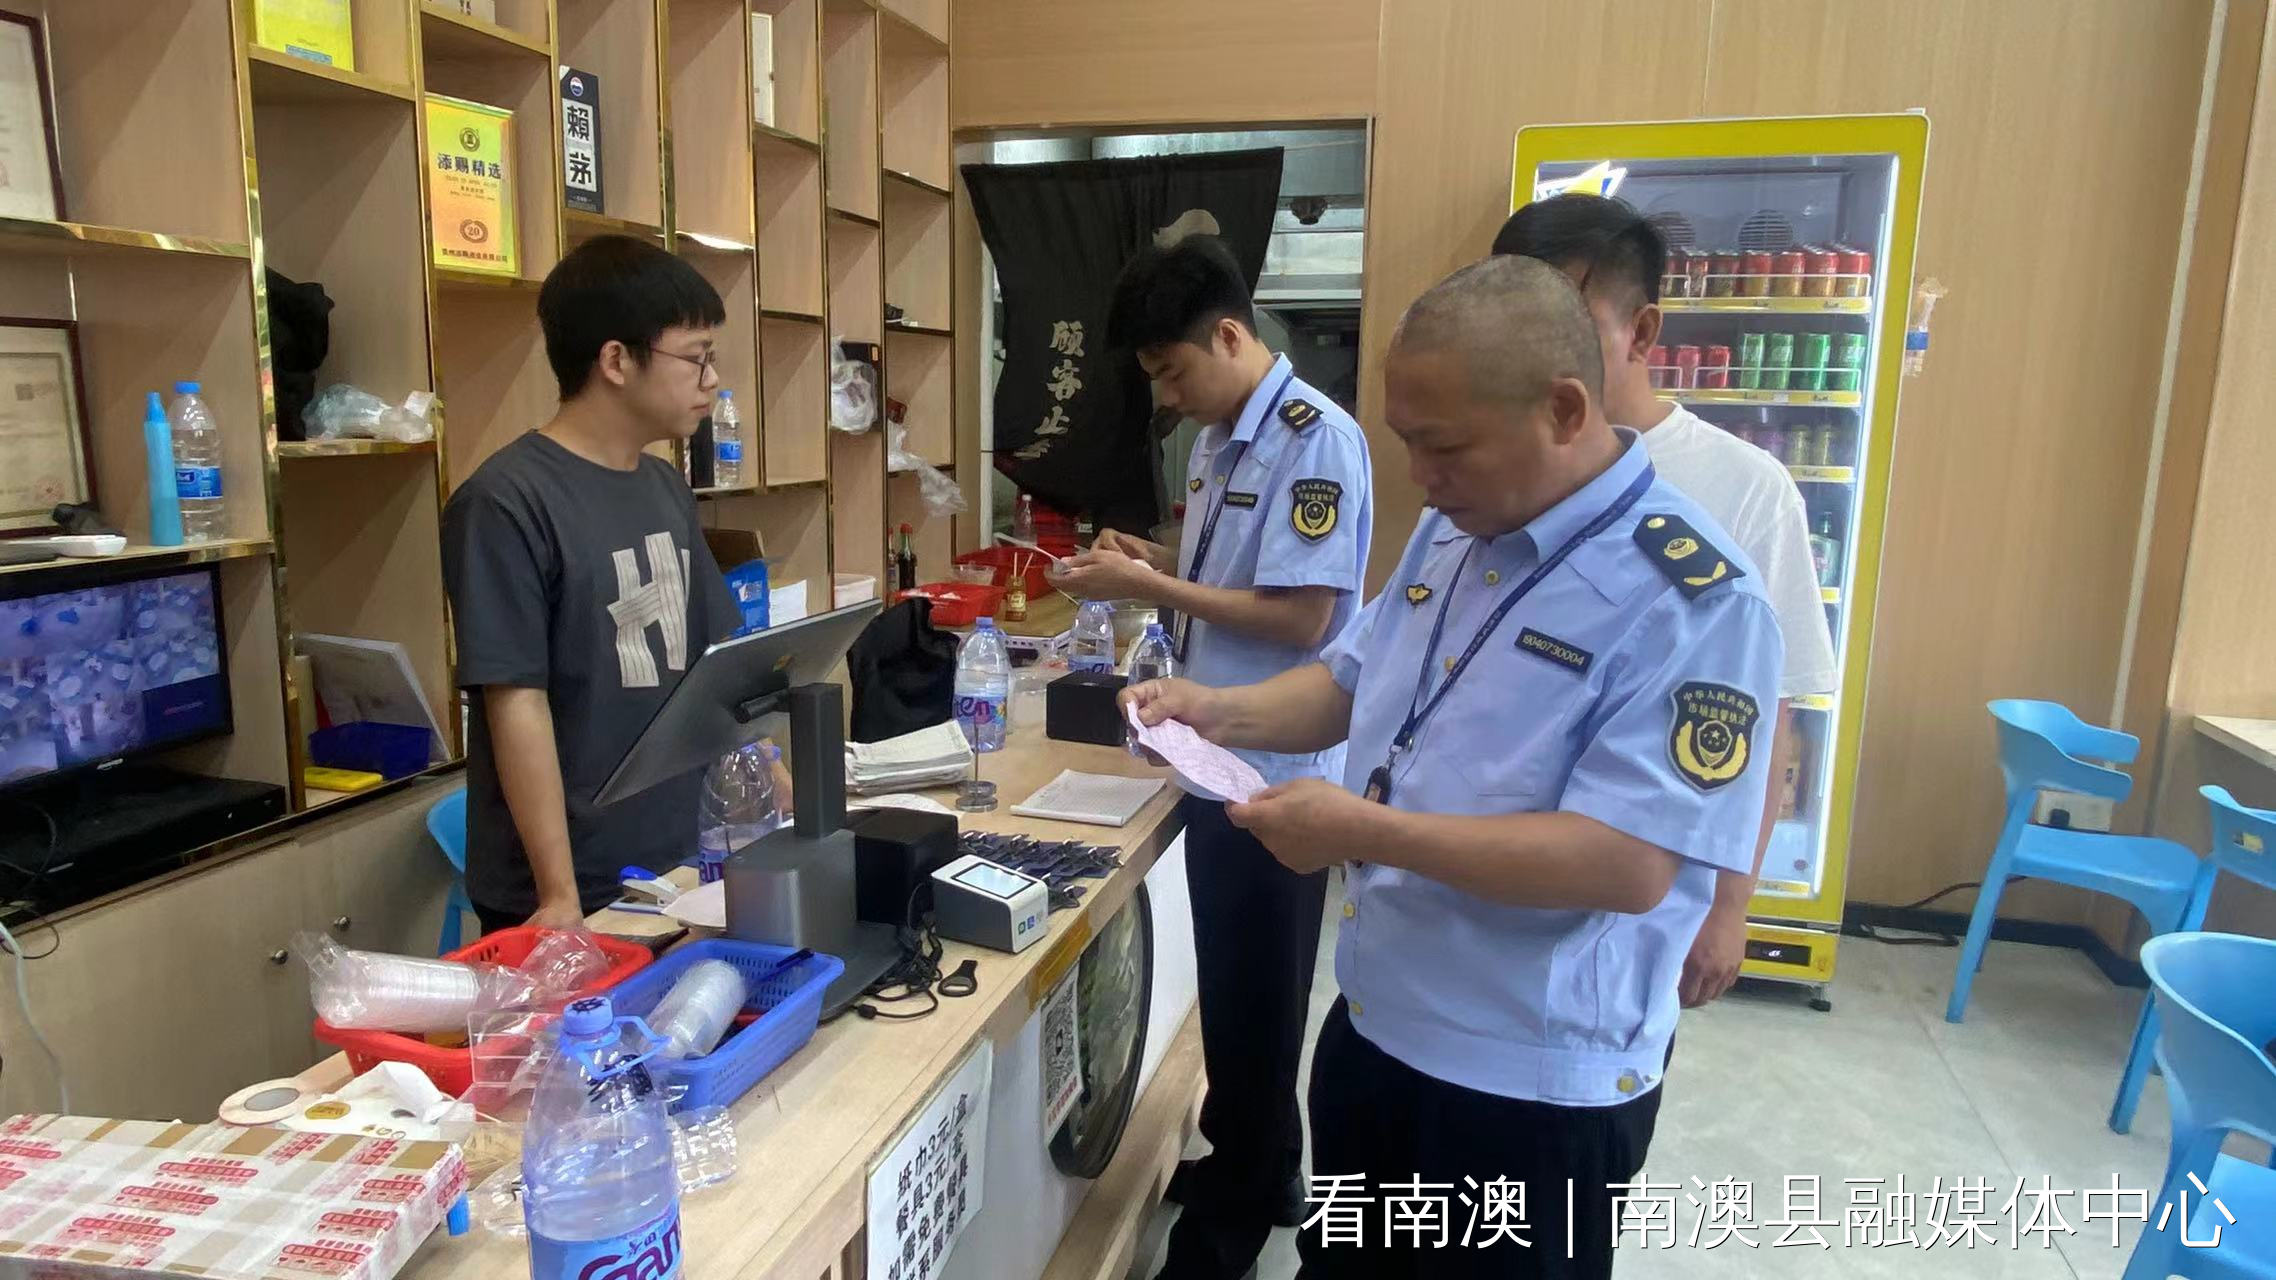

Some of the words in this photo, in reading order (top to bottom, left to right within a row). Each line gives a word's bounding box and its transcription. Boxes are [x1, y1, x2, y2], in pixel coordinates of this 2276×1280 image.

[896, 1127, 964, 1241] 餐具3元/套
[897, 1093, 968, 1202] 纸巾3元/盒
